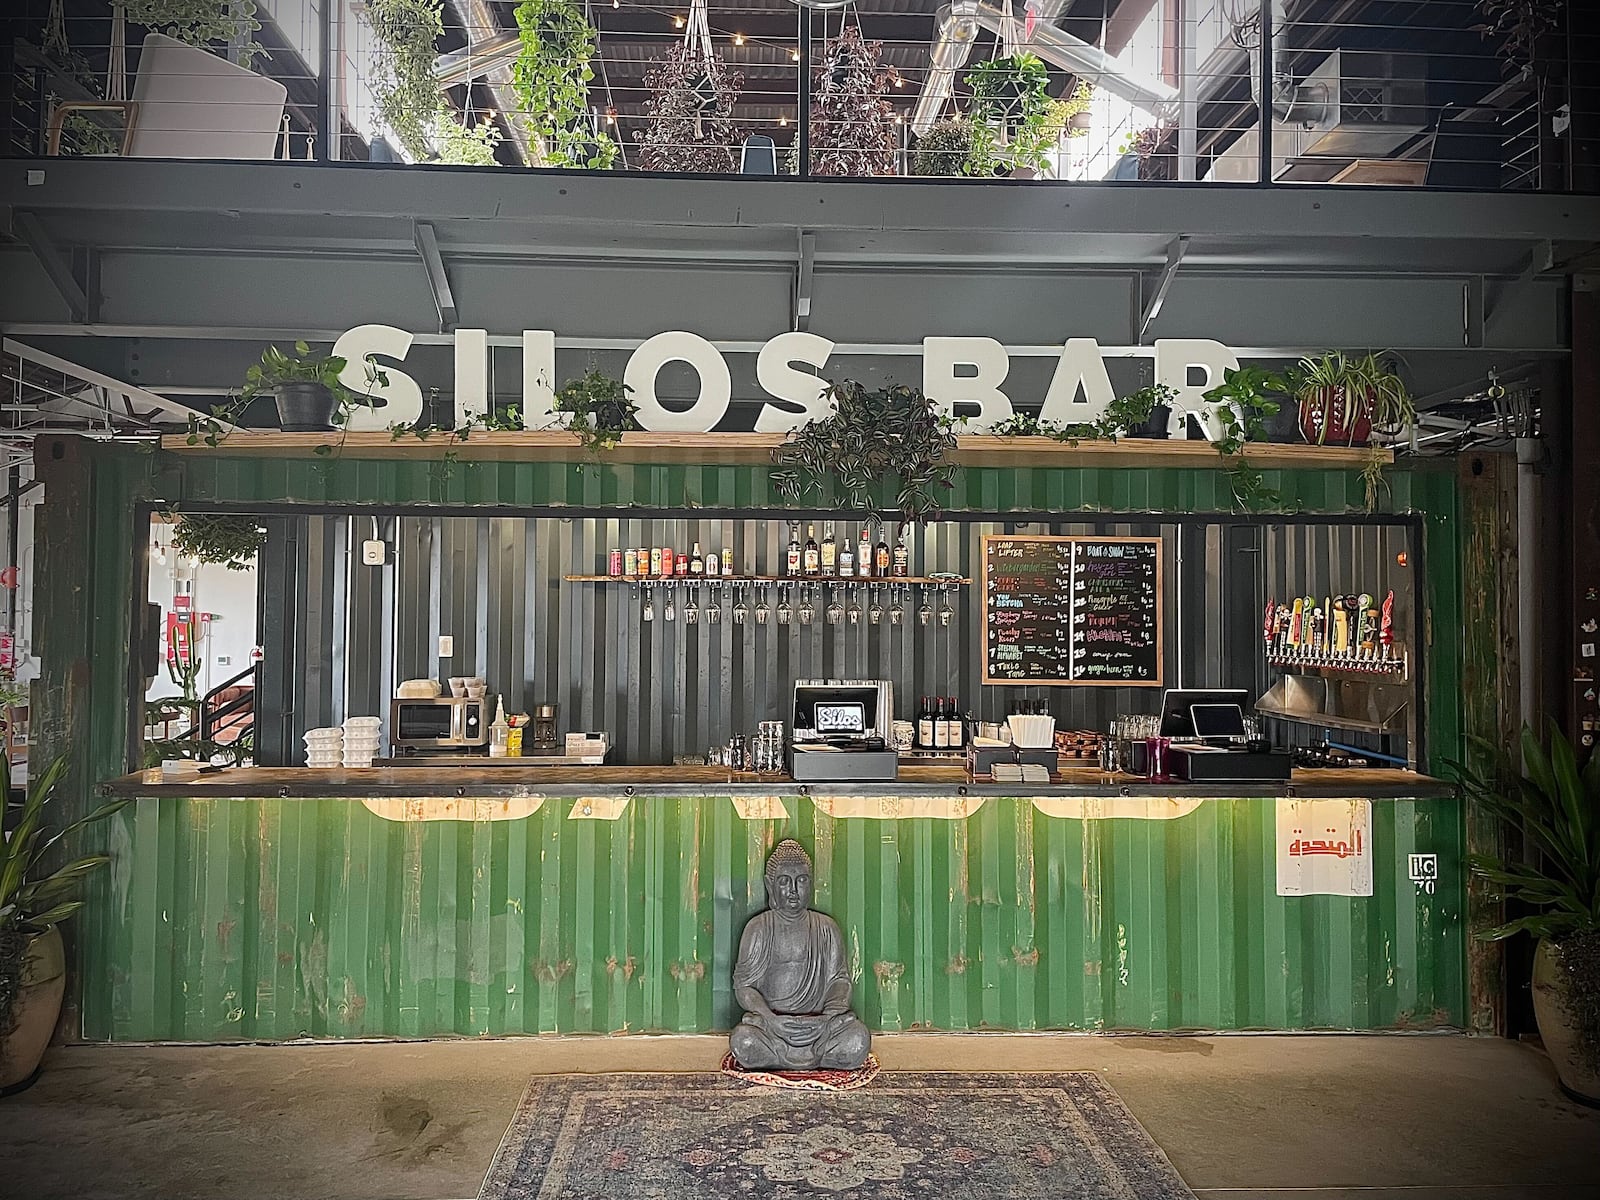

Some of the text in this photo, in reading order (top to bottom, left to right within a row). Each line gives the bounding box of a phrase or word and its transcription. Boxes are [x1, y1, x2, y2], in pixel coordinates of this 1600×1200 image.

[331, 324, 1243, 440] SILOS BAR
[820, 708, 861, 725] Silos
[1290, 828, 1362, 858] المتحدة
